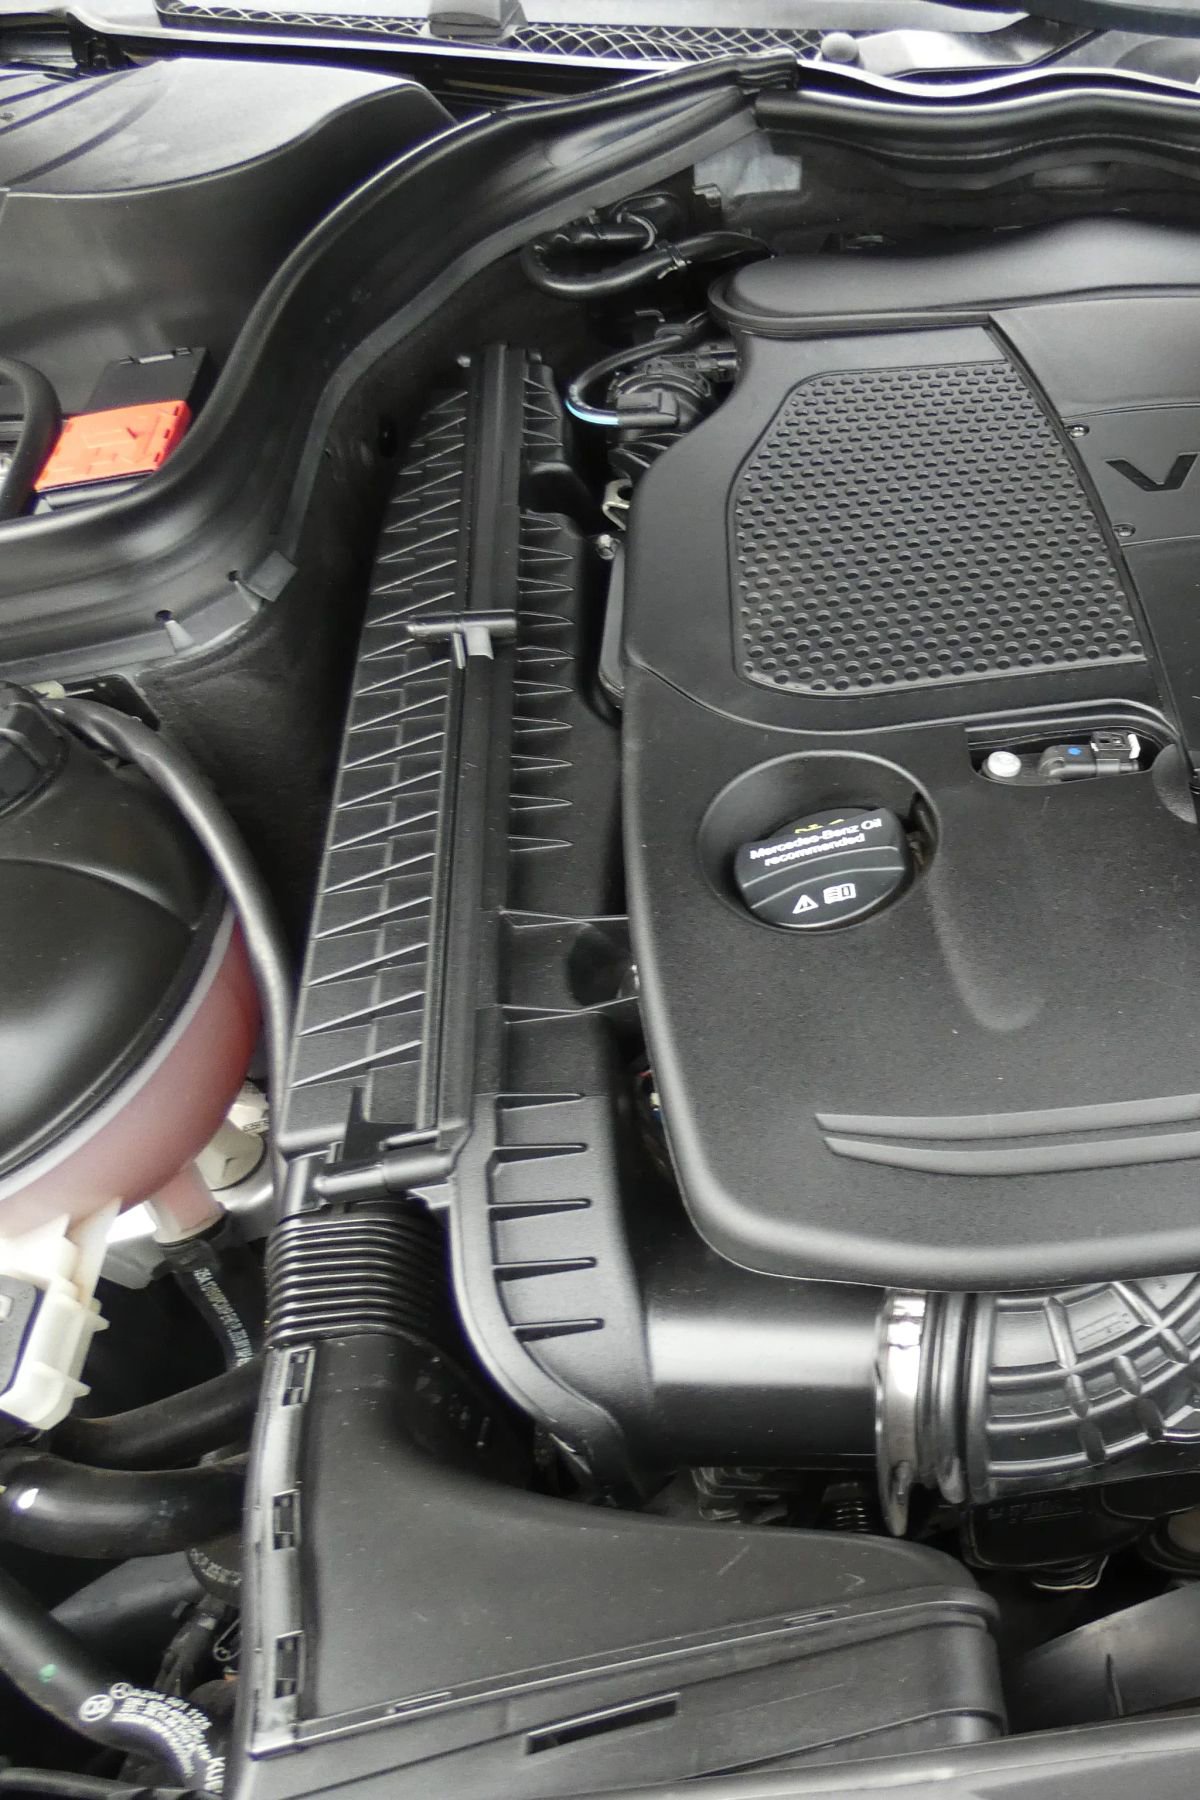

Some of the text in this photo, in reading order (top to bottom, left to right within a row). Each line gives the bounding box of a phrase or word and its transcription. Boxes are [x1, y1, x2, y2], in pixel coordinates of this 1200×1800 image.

[750, 818, 882, 859] Mercedes-Benz Oil
[765, 834, 866, 866] recommended
